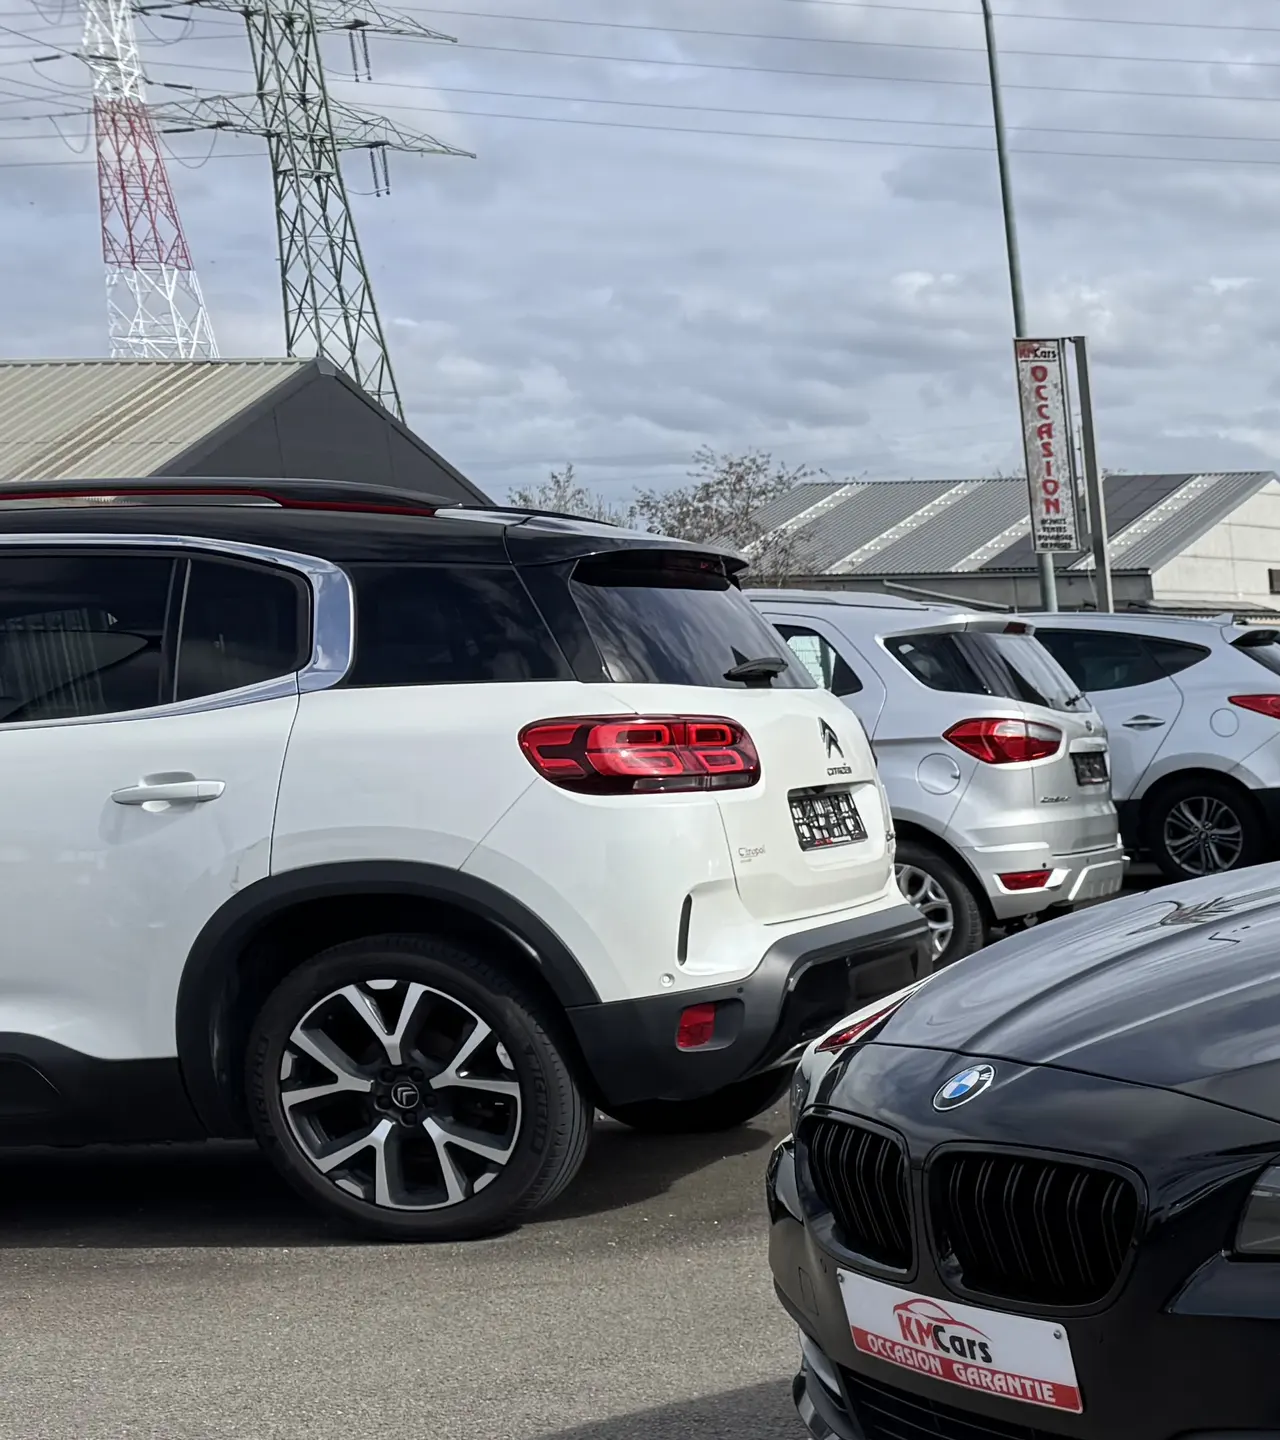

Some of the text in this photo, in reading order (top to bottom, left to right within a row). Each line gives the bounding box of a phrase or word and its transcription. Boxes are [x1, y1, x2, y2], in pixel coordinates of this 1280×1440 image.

[1031, 365, 1061, 514] OCCASION
[867, 1335, 1057, 1403] OCCASION GARANTIE
[896, 1311, 993, 1364] KMCars
